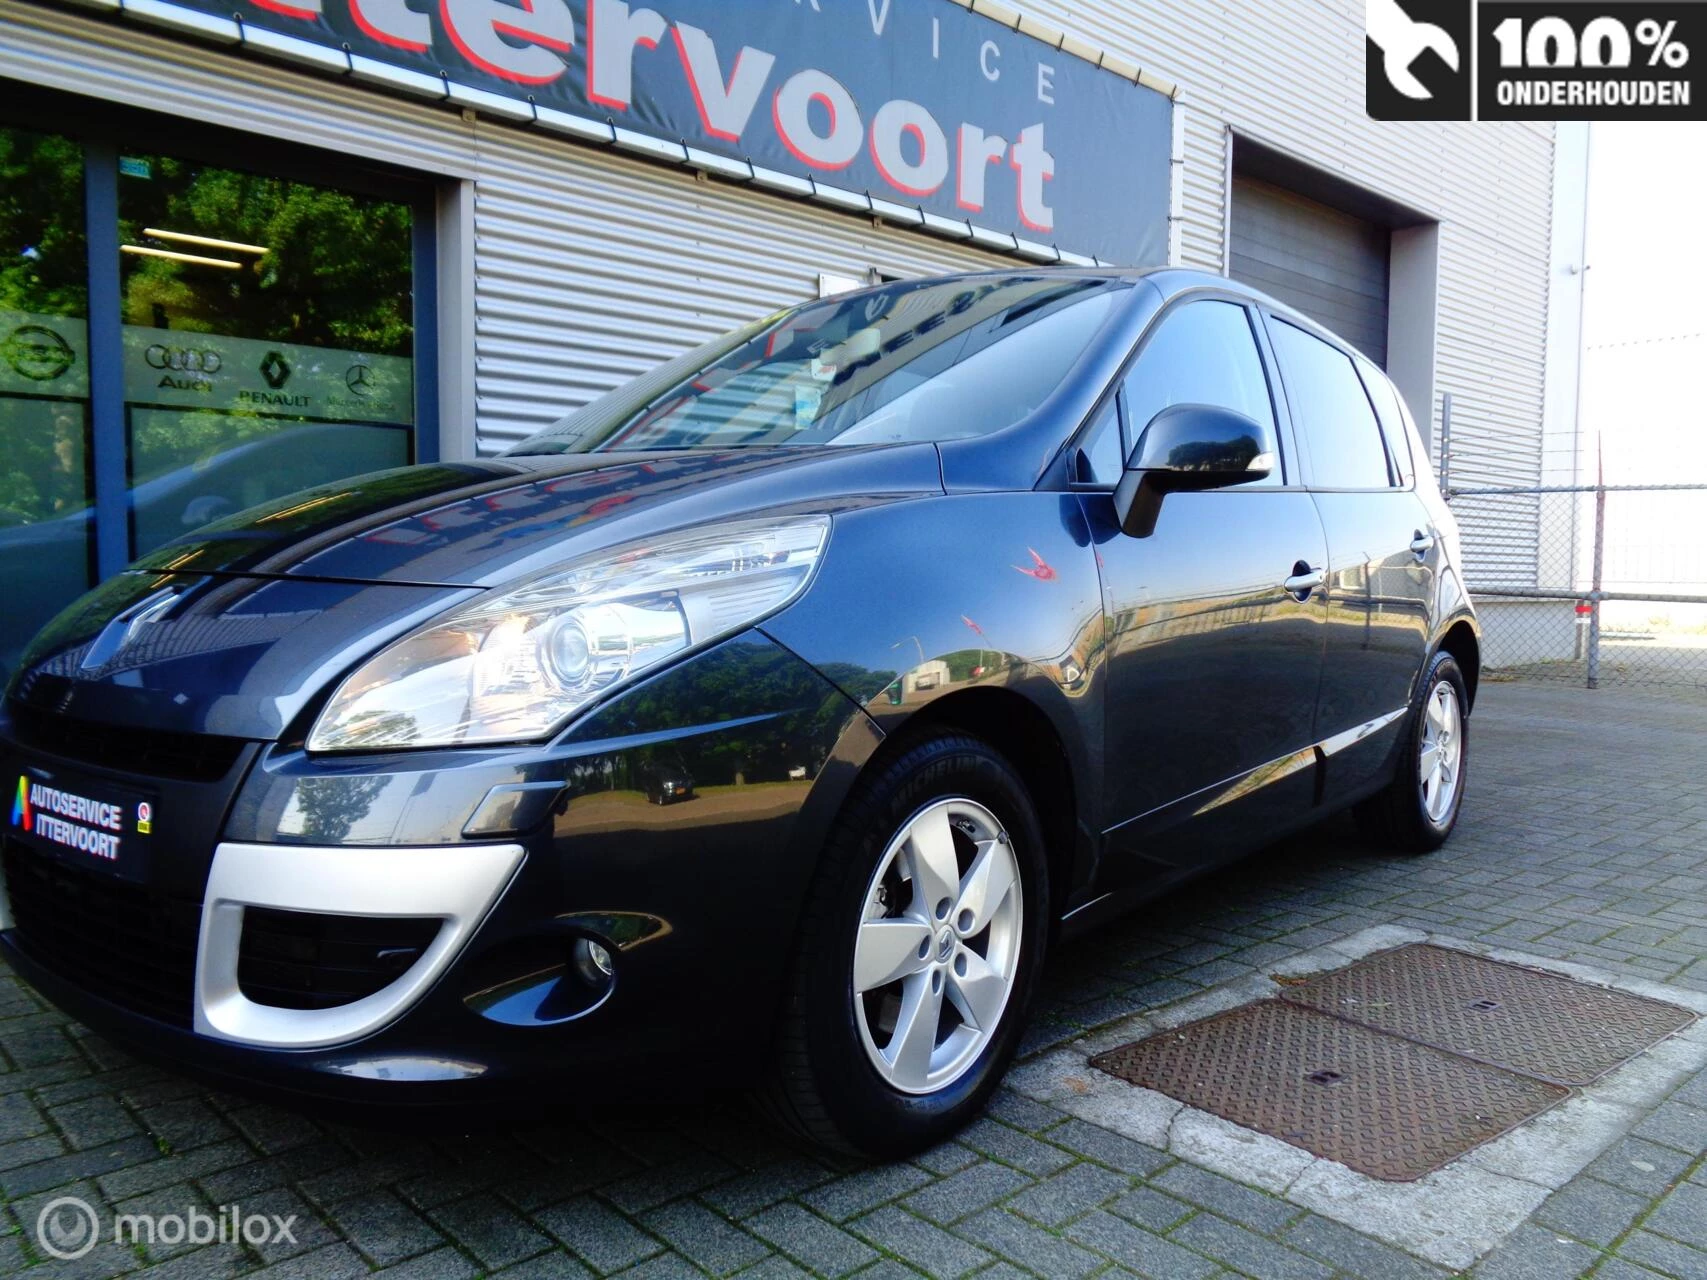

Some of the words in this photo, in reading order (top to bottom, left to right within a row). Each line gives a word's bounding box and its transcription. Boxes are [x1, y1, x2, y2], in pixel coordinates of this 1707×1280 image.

[795, 0, 1055, 105] VICE
[249, 0, 1055, 232] ervoort
[157, 374, 212, 392] Audi
[239, 389, 312, 408] RENAULT
[30, 783, 121, 830] AUTOSERVICE
[36, 813, 120, 860] ITTERVOORT
